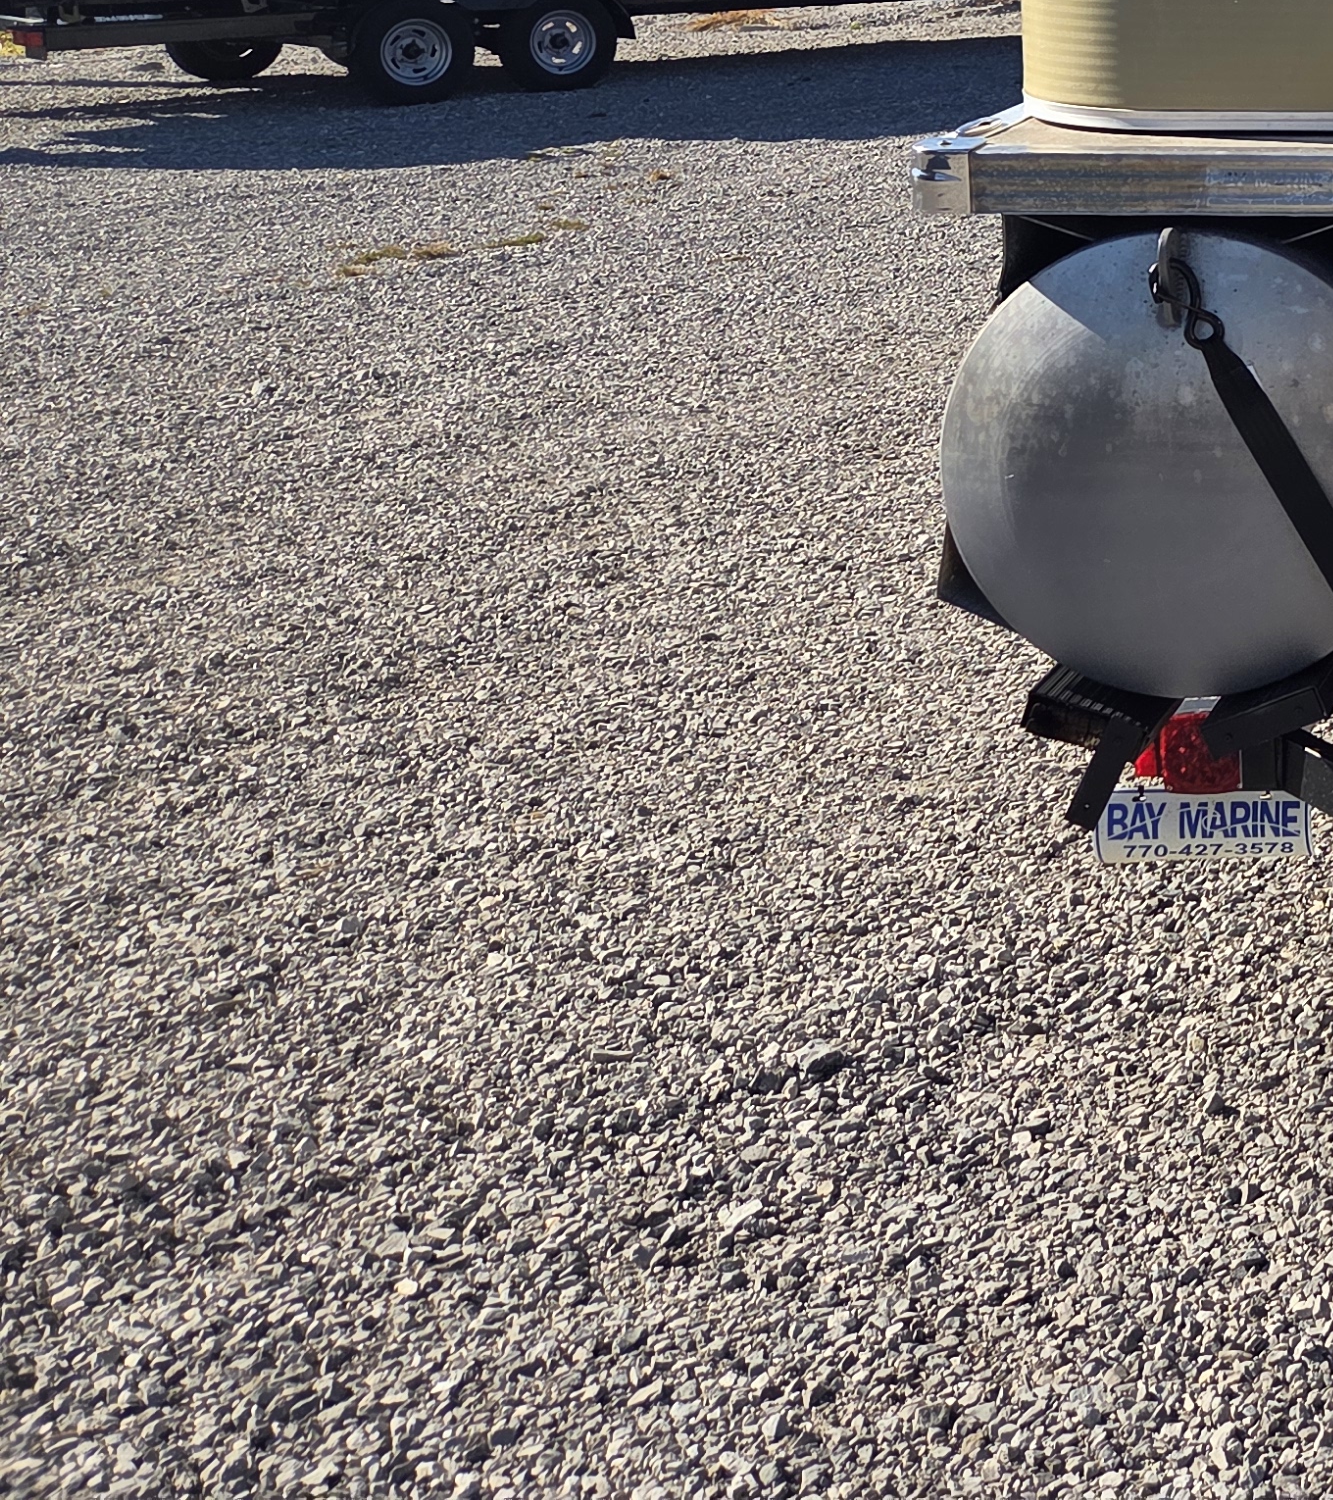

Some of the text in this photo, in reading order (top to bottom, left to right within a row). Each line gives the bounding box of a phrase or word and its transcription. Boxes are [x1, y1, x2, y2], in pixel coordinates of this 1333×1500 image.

[1107, 800, 1301, 841] BAY MARINE
[1123, 841, 1295, 859] 770-427-3578
